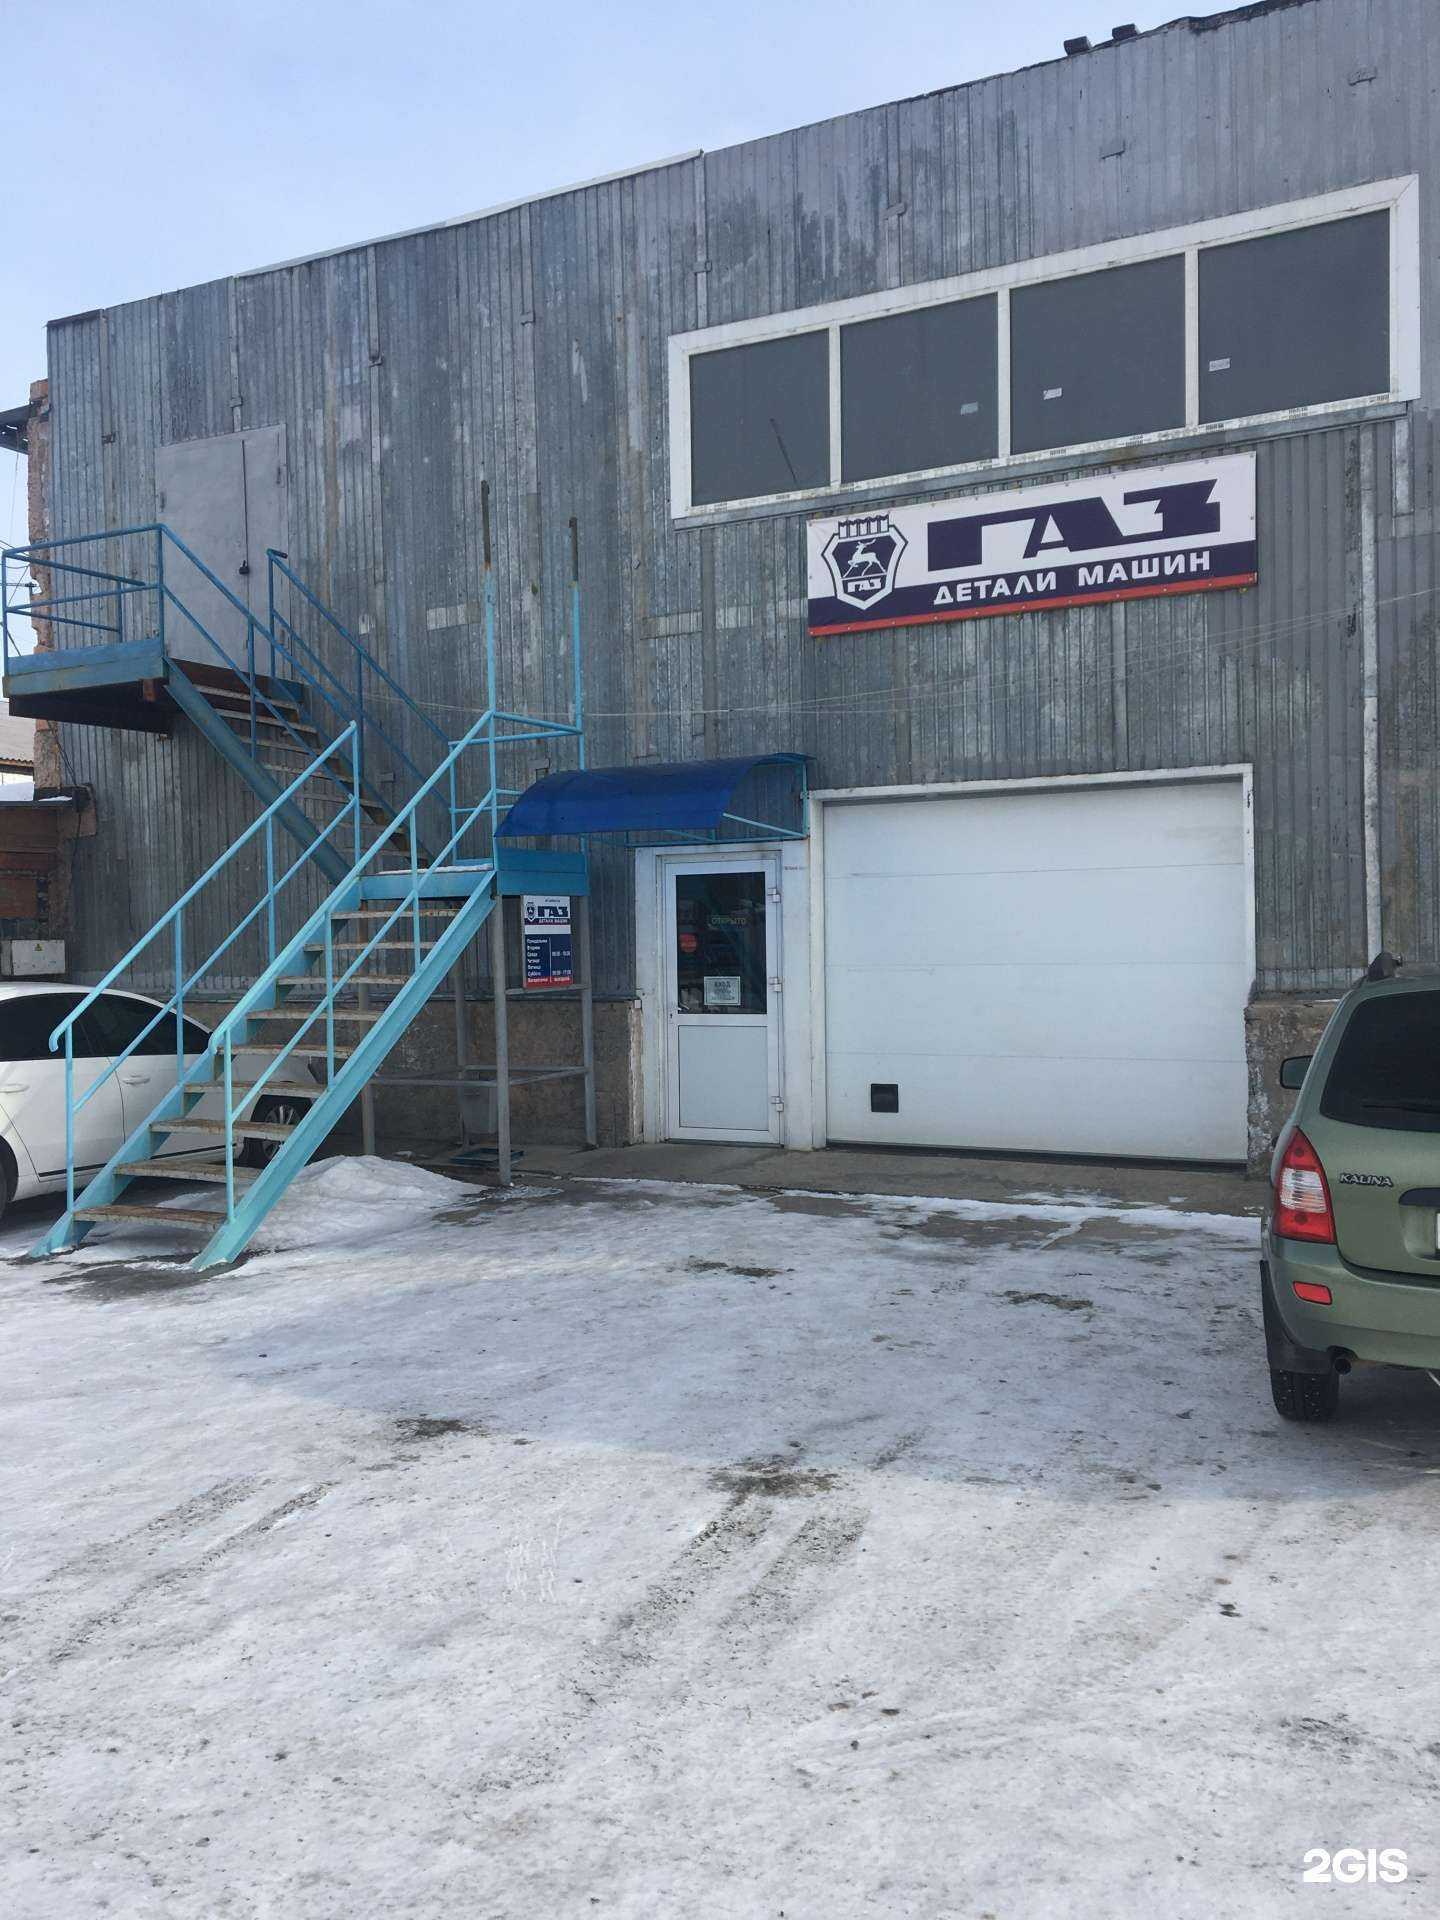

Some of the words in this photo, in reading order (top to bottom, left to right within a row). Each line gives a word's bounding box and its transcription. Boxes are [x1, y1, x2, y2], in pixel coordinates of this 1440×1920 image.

[928, 479, 1220, 571] ГАЗ
[848, 578, 881, 592] ГАЗ
[933, 571, 1056, 605] ДЕТАЛИ
[1078, 551, 1210, 586] МАШИН
[537, 906, 568, 917] ГАЗ
[1339, 1173, 1393, 1187] KALINA
